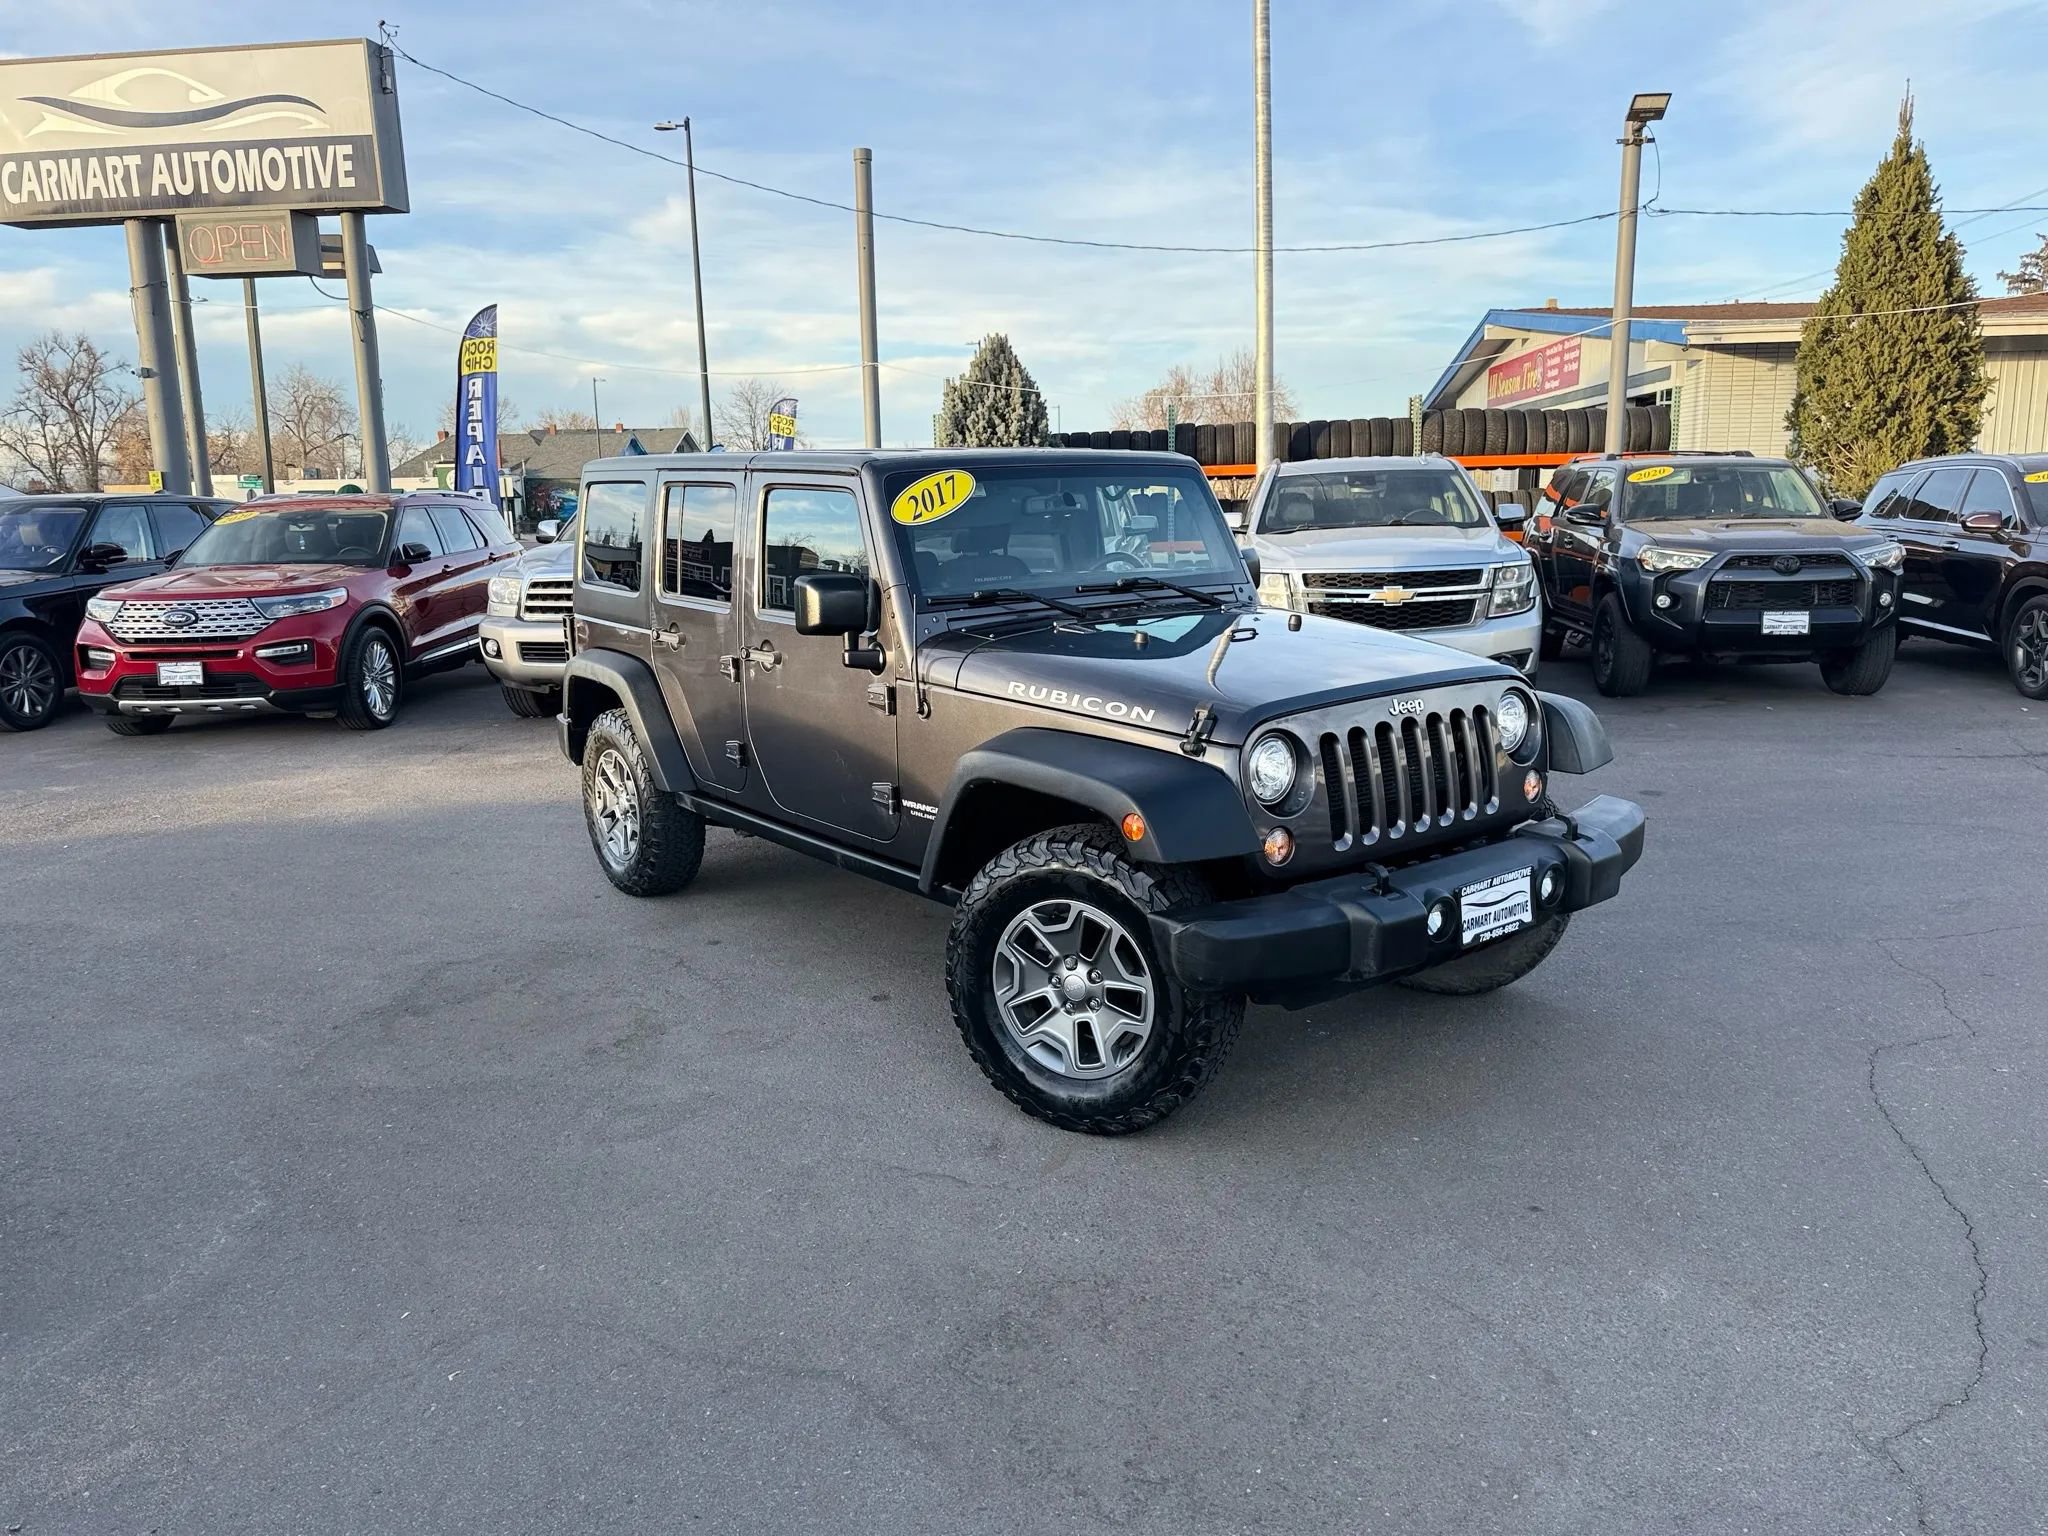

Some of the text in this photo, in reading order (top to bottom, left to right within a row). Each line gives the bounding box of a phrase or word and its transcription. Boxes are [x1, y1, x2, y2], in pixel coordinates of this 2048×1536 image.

[1, 144, 356, 204] CARMART AUTOMOTIVE
[188, 223, 288, 264] OPEN
[1497, 371, 1520, 398] Season
[1635, 467, 1666, 481] 2020
[907, 474, 955, 521] 2017
[1007, 681, 1156, 723] RUBICON
[1389, 698, 1425, 715] Jeep
[1461, 866, 1532, 897] CARMART AUTOMOTIVE
[1463, 900, 1529, 932] CARMART AUTOMOTIVE
